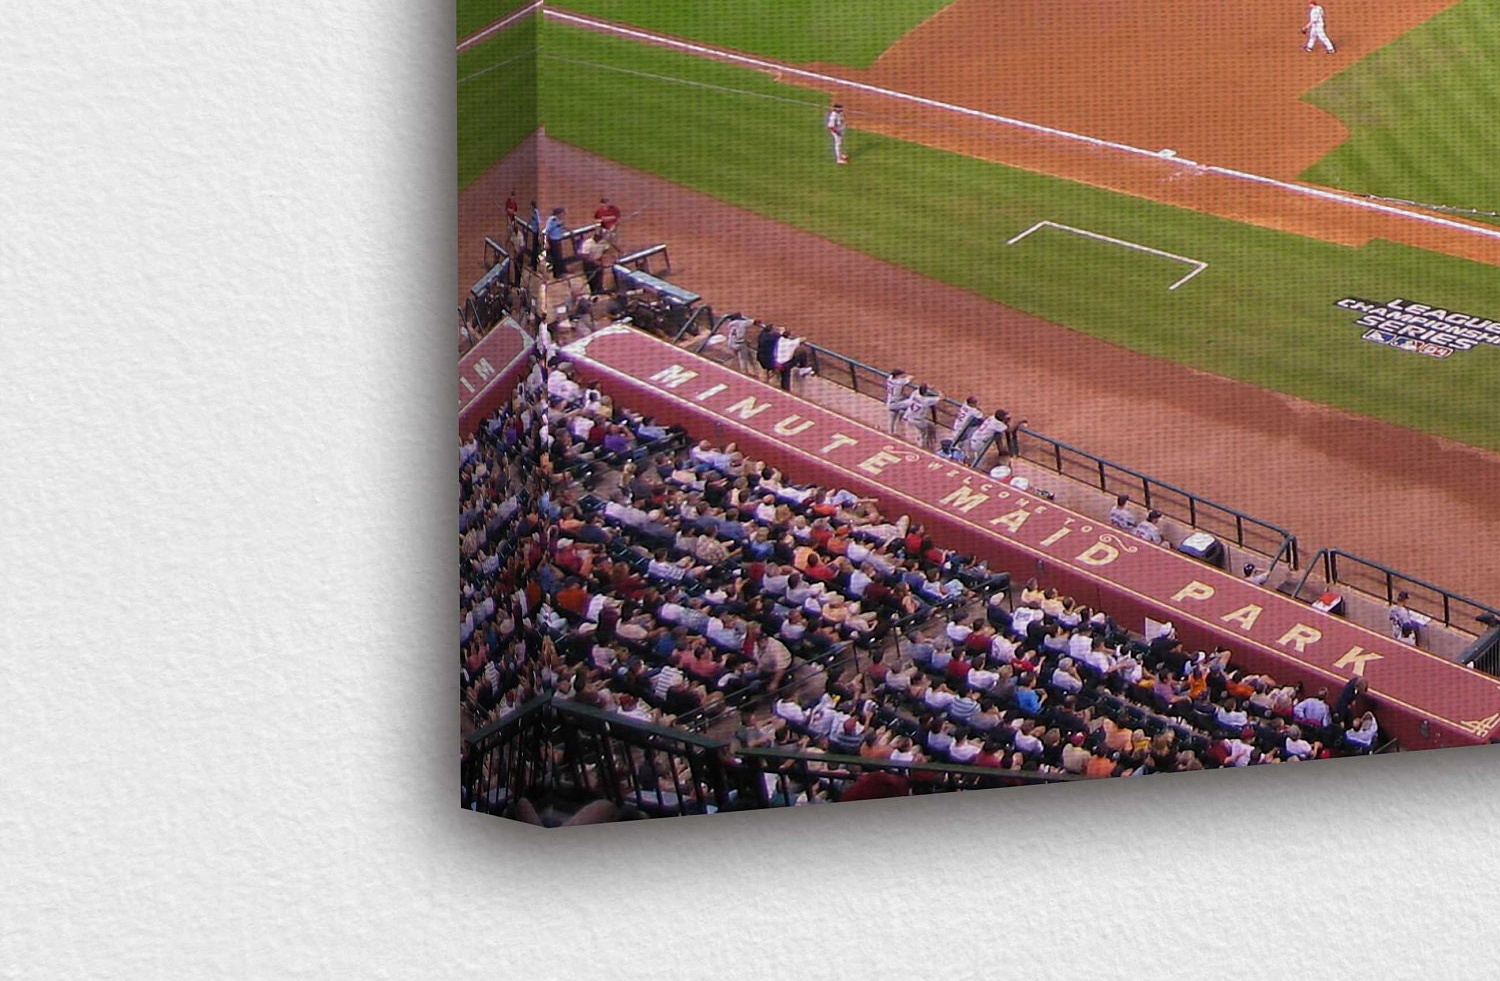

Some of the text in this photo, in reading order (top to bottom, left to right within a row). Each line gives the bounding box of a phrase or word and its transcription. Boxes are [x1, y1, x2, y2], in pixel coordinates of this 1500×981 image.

[1356, 315, 1479, 350] SERIES
[650, 363, 1385, 677] MINUTE MAID PARK
[927, 461, 1093, 534] WELCOME TO
